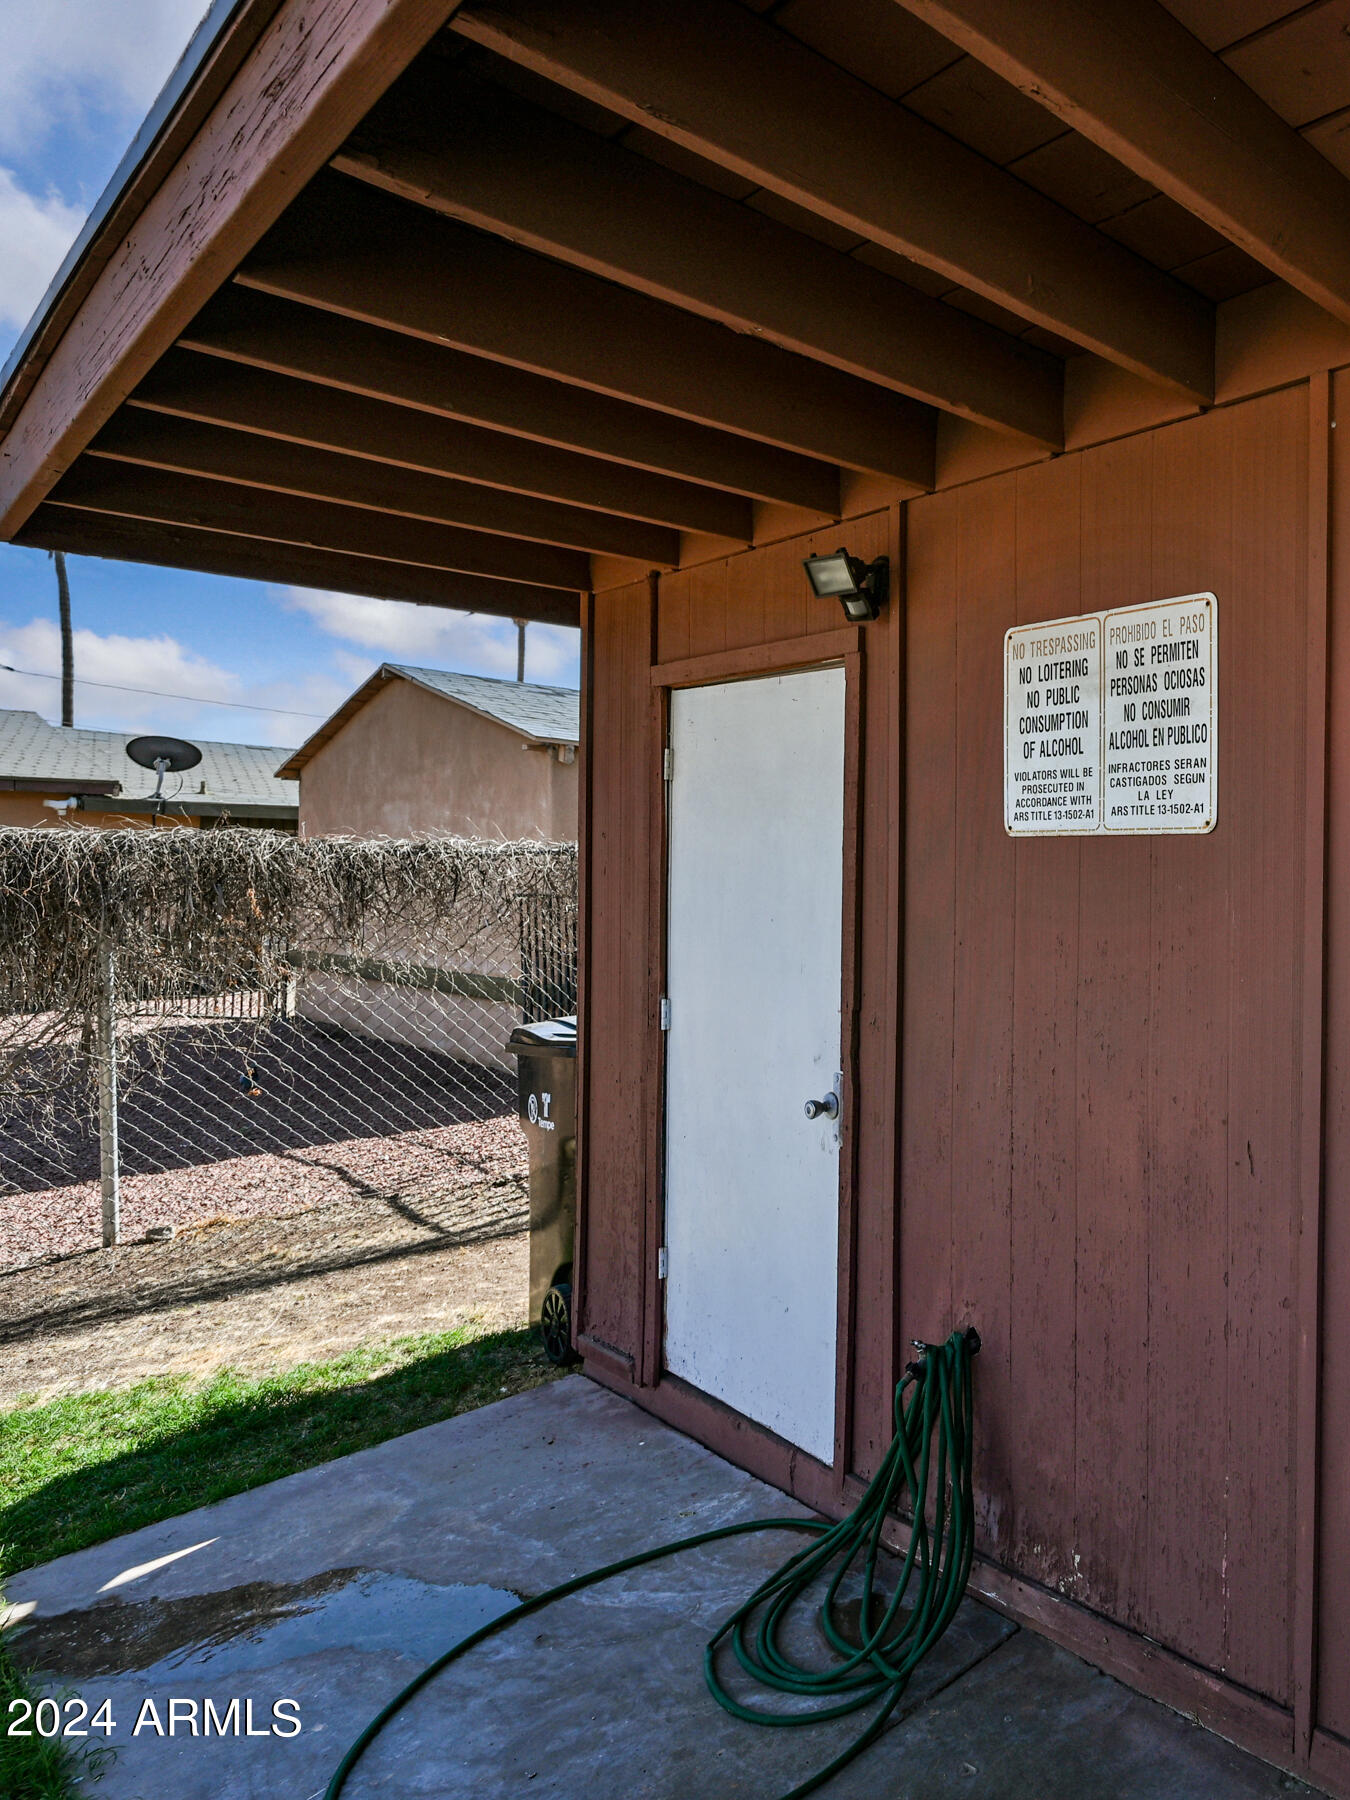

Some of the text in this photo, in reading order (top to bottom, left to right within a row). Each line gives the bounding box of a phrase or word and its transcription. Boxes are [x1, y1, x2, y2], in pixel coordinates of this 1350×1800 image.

[1110, 613, 1205, 645] PROHIBIDO EL PASO
[1012, 631, 1096, 661] NO TRESPASSING
[1116, 639, 1199, 669] NO SE PERMITEN
[1019, 658, 1088, 685] NO LOITERING
[1110, 666, 1205, 697] PERSONAS OCIOSAS
[1027, 685, 1080, 708] NO PUBLIC
[1124, 697, 1190, 722] NO CONSUMIR
[1019, 710, 1089, 734] CONSUMPTION
[1109, 723, 1207, 750] ALCOHOL EN PUBLICO
[1023, 737, 1084, 759] OF ALCOHOL
[1014, 767, 1093, 781] VIOLATORS WILL BE
[1108, 757, 1207, 774] INFRACTORES SERAN
[1021, 782, 1085, 794] PROSECUTED IN
[1109, 773, 1205, 788] CASTIGADOS SEGUN
[1015, 795, 1092, 808] ACCORDANCE WITH
[1138, 789, 1174, 801] LA LEY
[1013, 809, 1094, 821] ARS TITLE 13-1502-A1
[1111, 803, 1204, 816] ARS TITLE 13-1502-A1
[537, 1116, 555, 1131] Tempe
